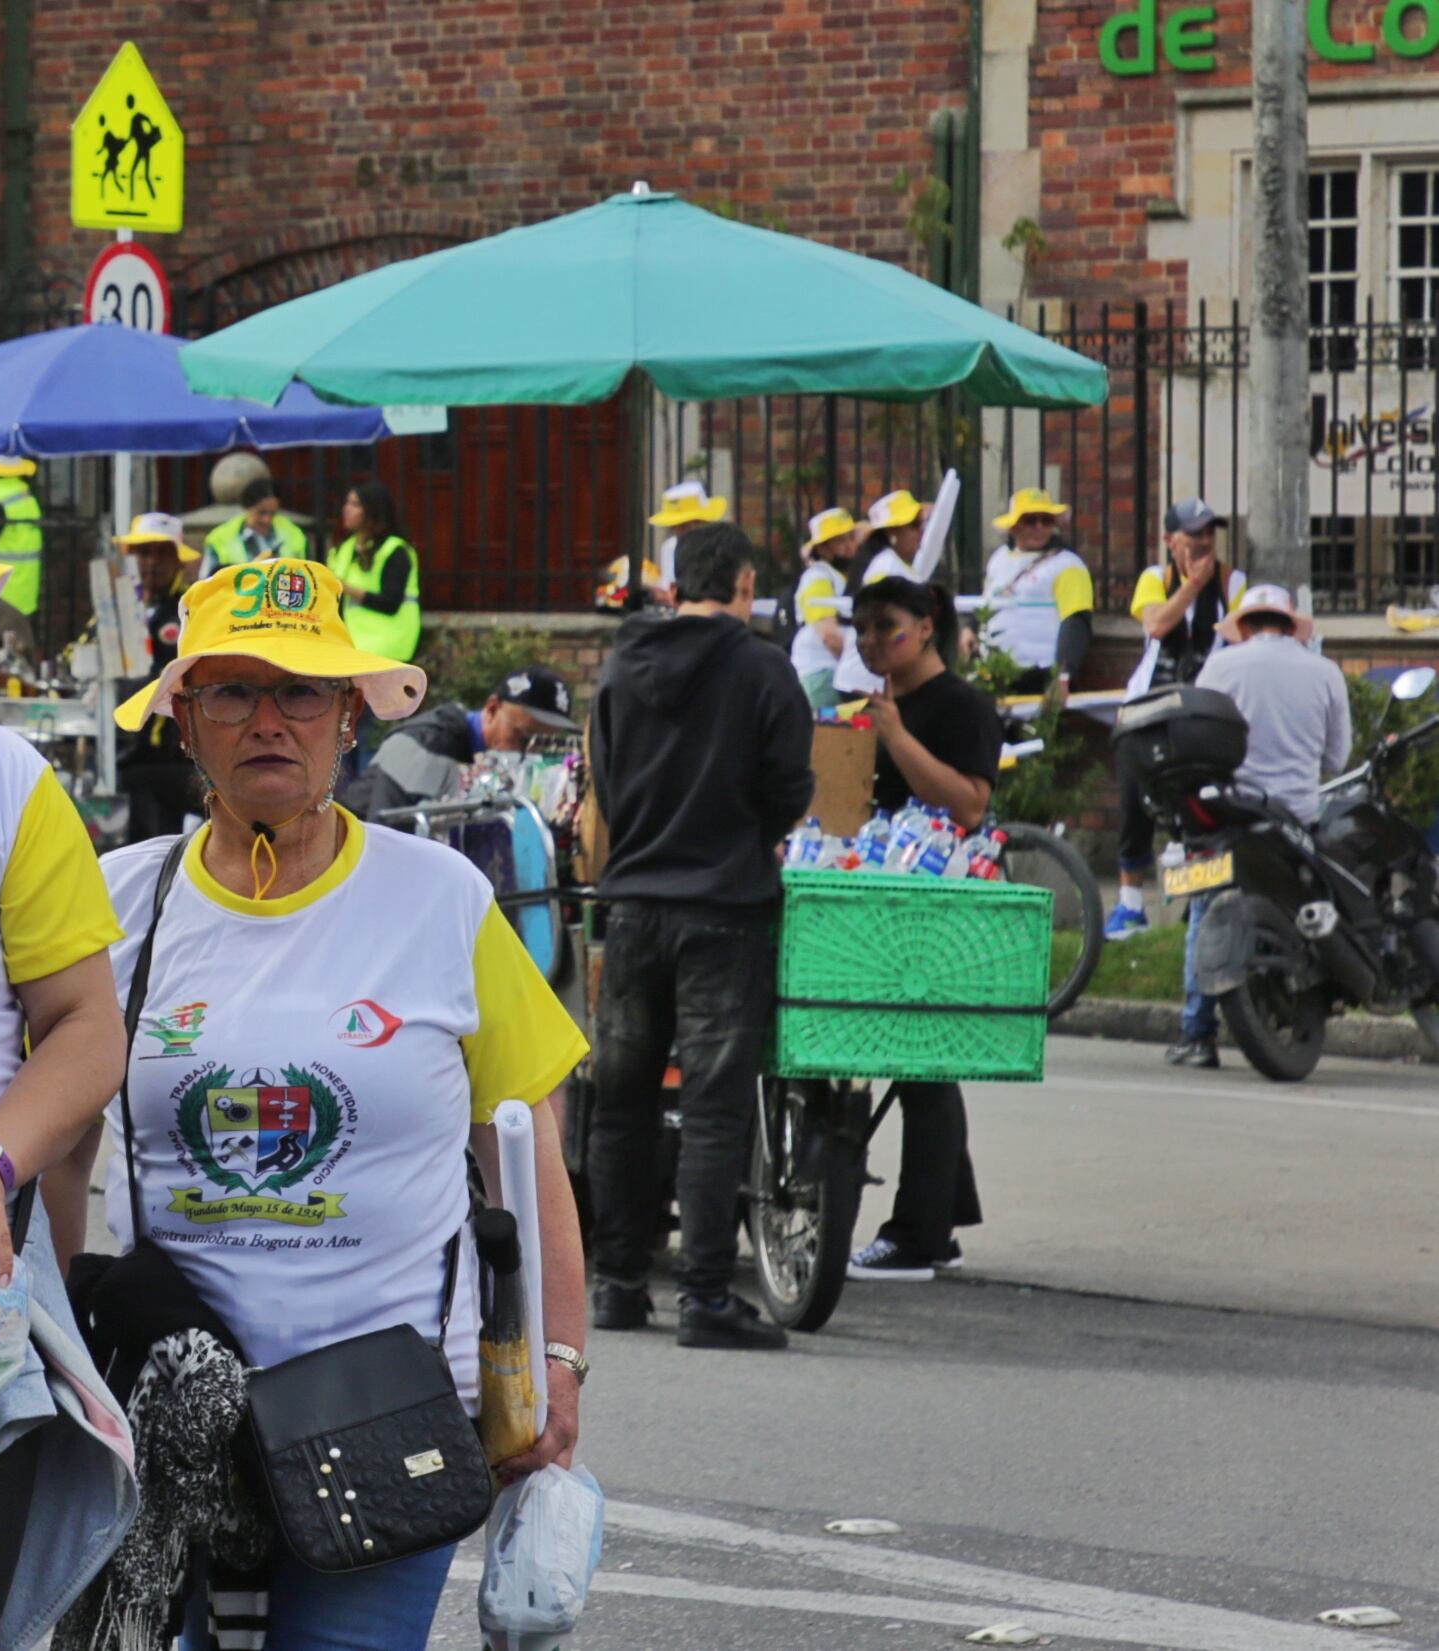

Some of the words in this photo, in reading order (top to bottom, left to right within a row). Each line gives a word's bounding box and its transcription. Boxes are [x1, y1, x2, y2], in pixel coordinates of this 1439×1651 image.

[1098, 0, 1216, 76] de
[102, 282, 152, 332] 30
[169, 1060, 217, 1102] TRABAJO
[310, 1060, 358, 1124] HONESTIDAD
[346, 1127, 357, 1135] Y
[313, 1139, 352, 1185] SERVICIO
[187, 1203, 229, 1219] Fundado
[231, 1203, 263, 1217] Mayo
[266, 1203, 279, 1213] 15
[281, 1203, 294, 1214] de
[297, 1206, 324, 1219] 1934
[150, 1225, 246, 1247] Sintrauniobras
[249, 1233, 301, 1251] Bogotá
[304, 1238, 324, 1249] 90
[327, 1236, 363, 1248] Años
